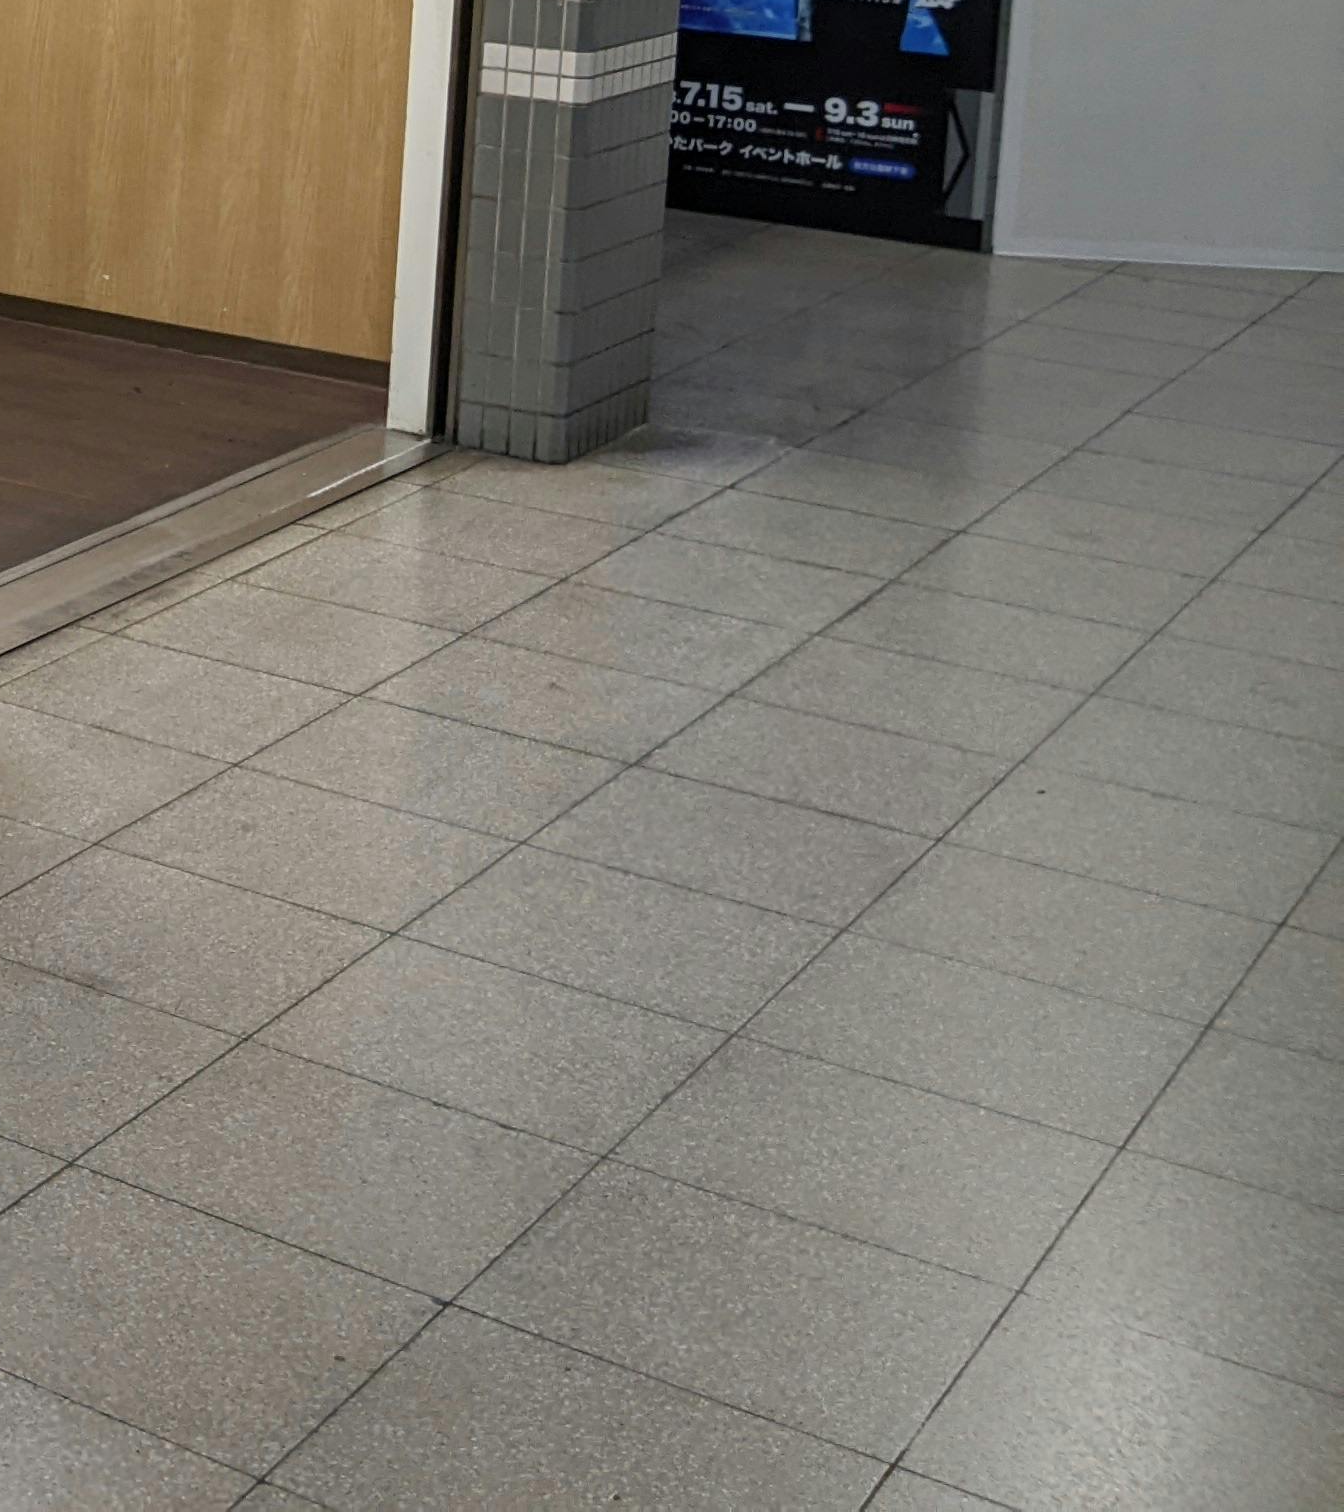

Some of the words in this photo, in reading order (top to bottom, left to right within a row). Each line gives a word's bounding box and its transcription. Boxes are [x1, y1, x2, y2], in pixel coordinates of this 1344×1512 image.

[824, 96, 879, 127] 9.3
[670, 135, 733, 157] たパーク
